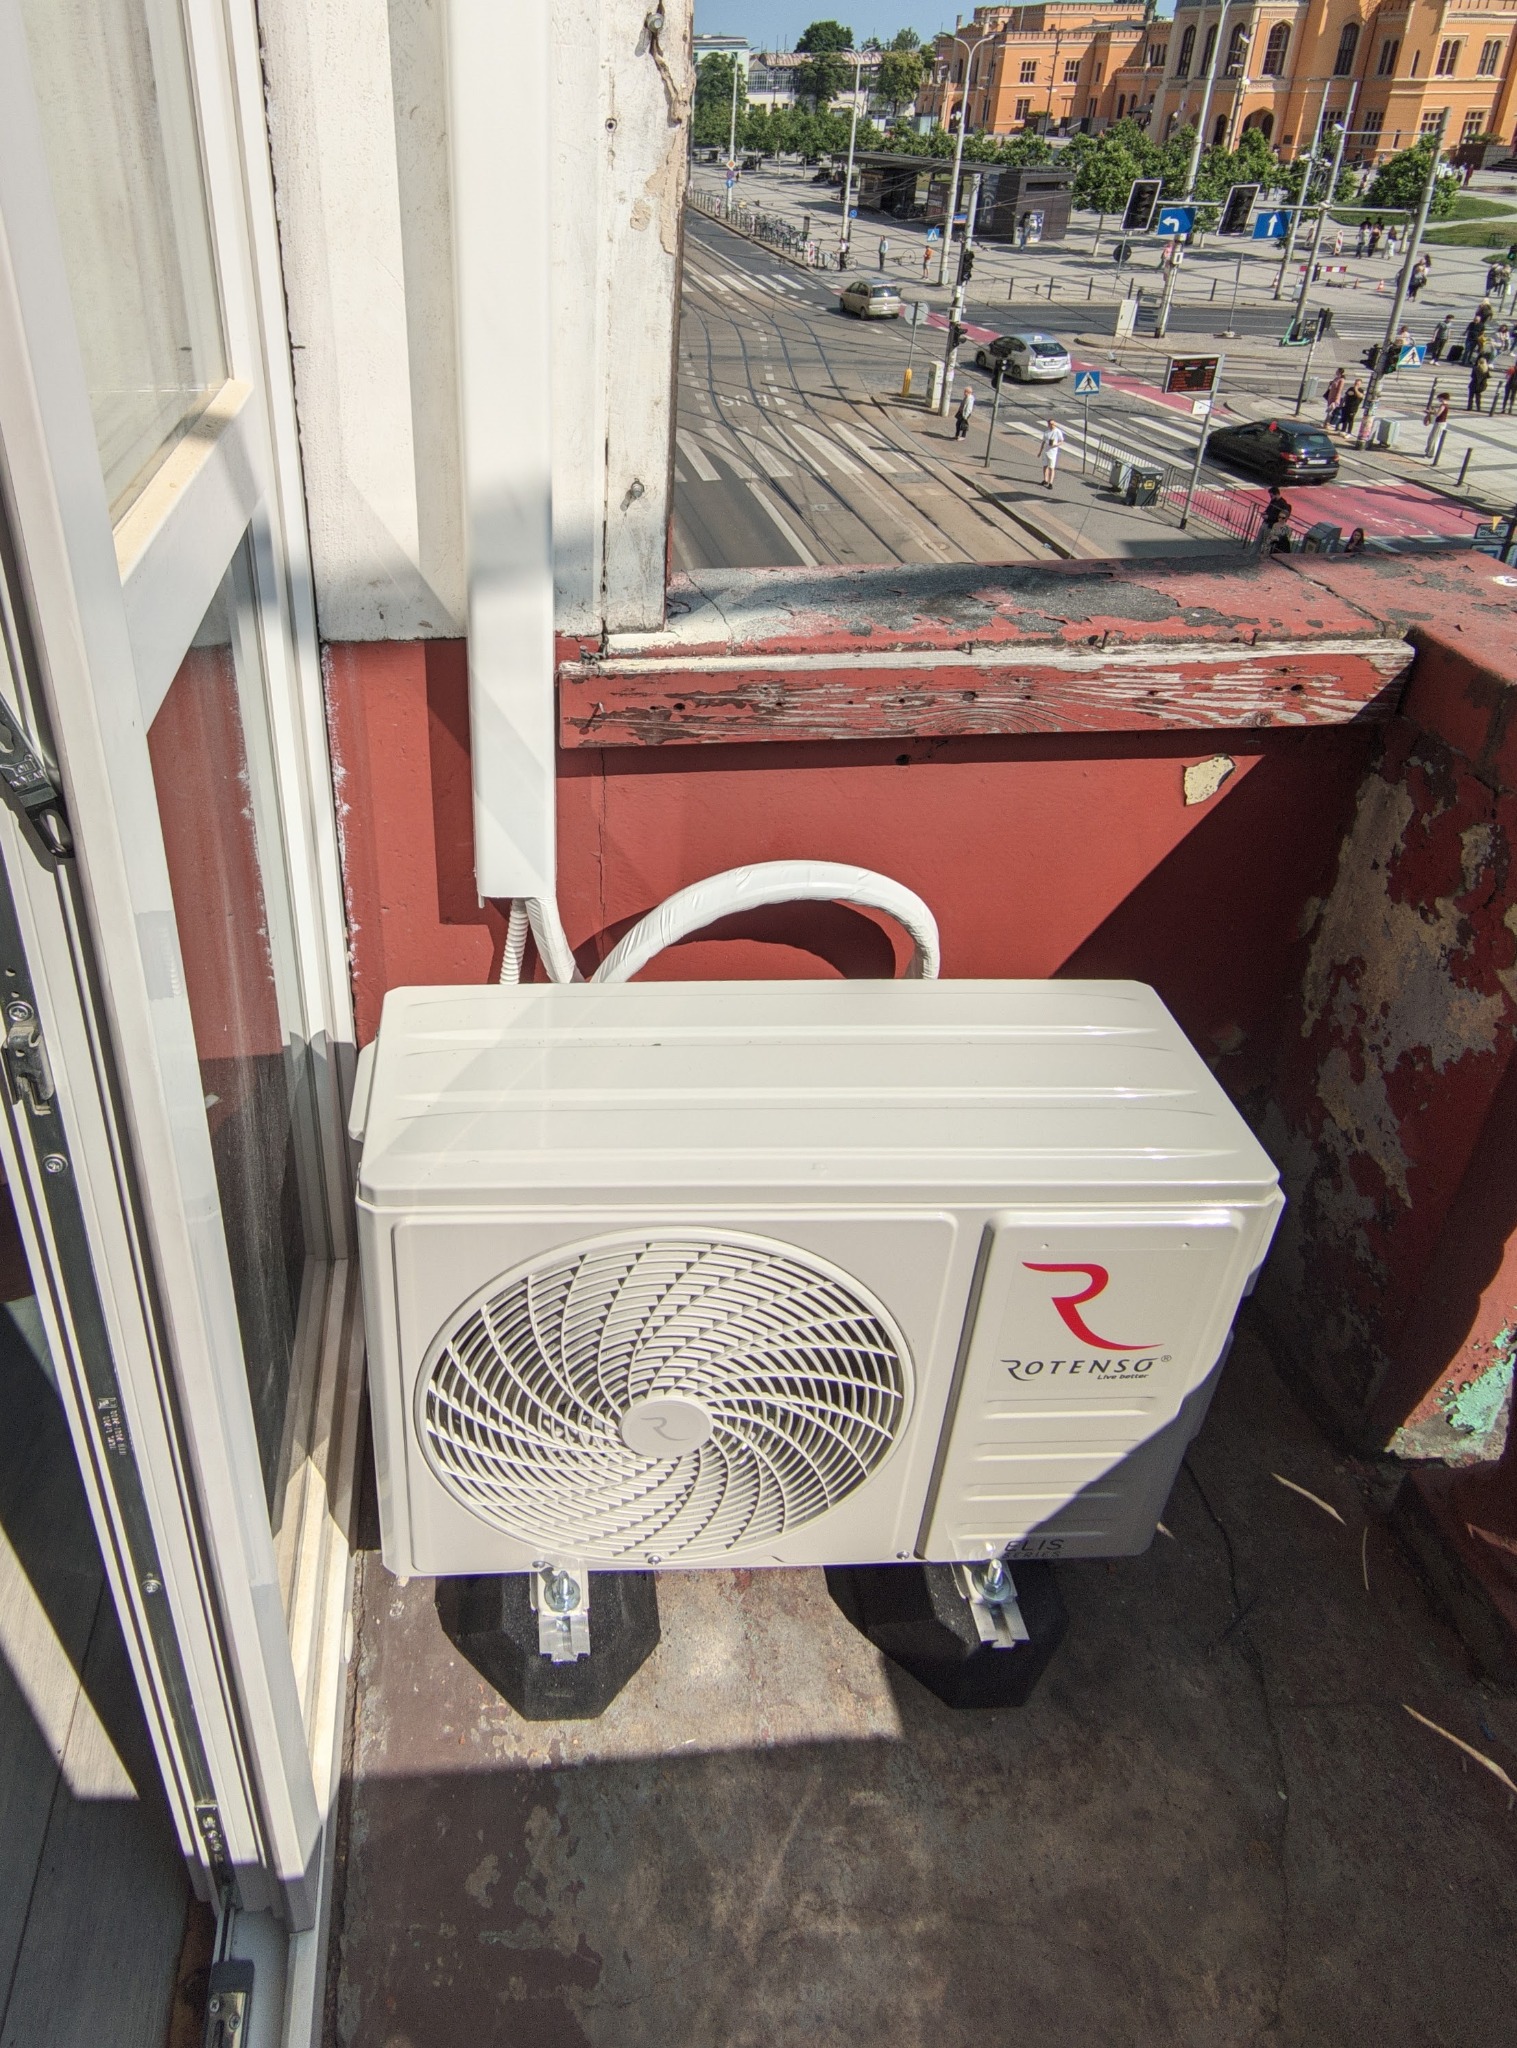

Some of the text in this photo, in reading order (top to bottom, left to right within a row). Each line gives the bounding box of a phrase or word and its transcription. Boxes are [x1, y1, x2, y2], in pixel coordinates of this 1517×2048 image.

[720, 394, 769, 407] BUS
[1004, 1539, 1064, 1552] ELIS
[1002, 1551, 1061, 1559] SERIES
